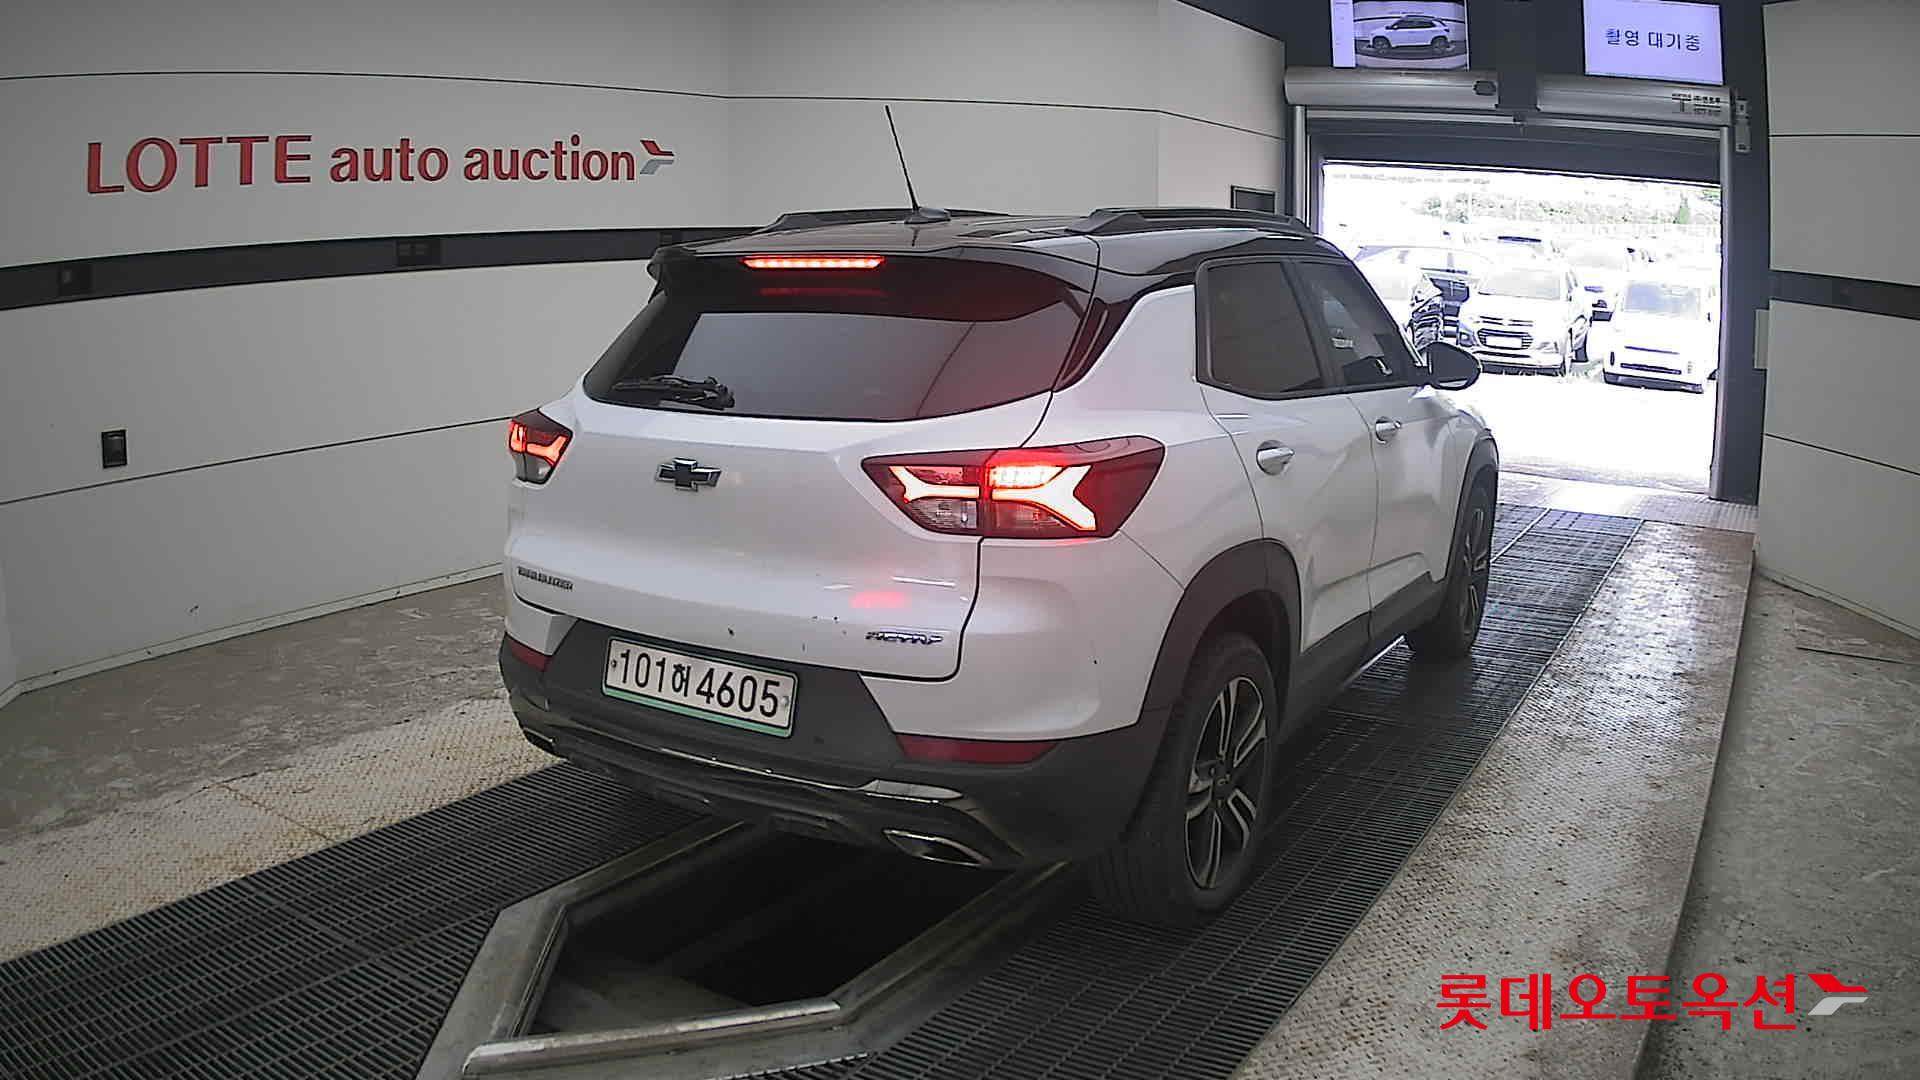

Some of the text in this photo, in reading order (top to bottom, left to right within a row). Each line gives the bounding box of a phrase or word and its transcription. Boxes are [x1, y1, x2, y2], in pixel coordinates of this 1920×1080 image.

[1605, 28, 1640, 47] 촬영
[86, 133, 637, 195] LOTTE auto auction
